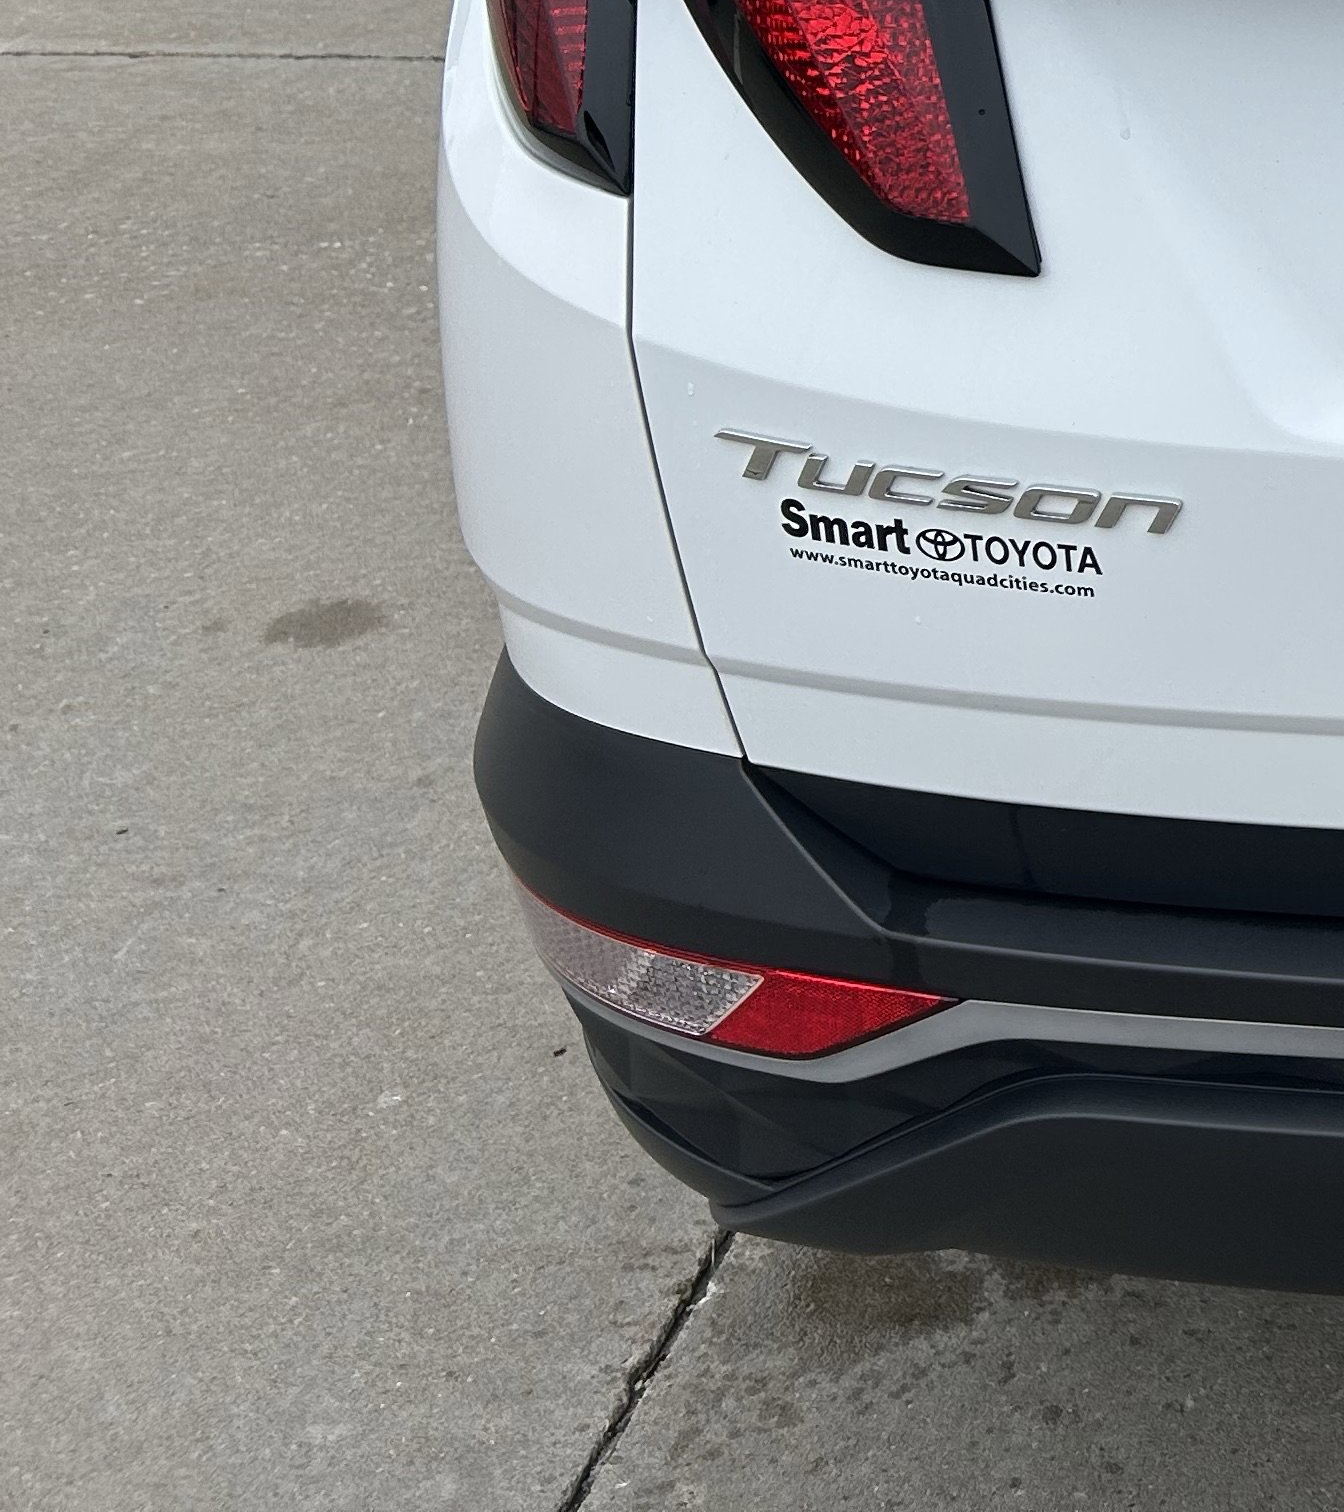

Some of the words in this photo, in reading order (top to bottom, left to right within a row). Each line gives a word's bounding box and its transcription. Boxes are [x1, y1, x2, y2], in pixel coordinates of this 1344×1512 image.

[780, 498, 912, 555] Smart
[962, 533, 1103, 576] TOYOTA
[789, 547, 1096, 598] www.smarttoyotaquadcities.com
